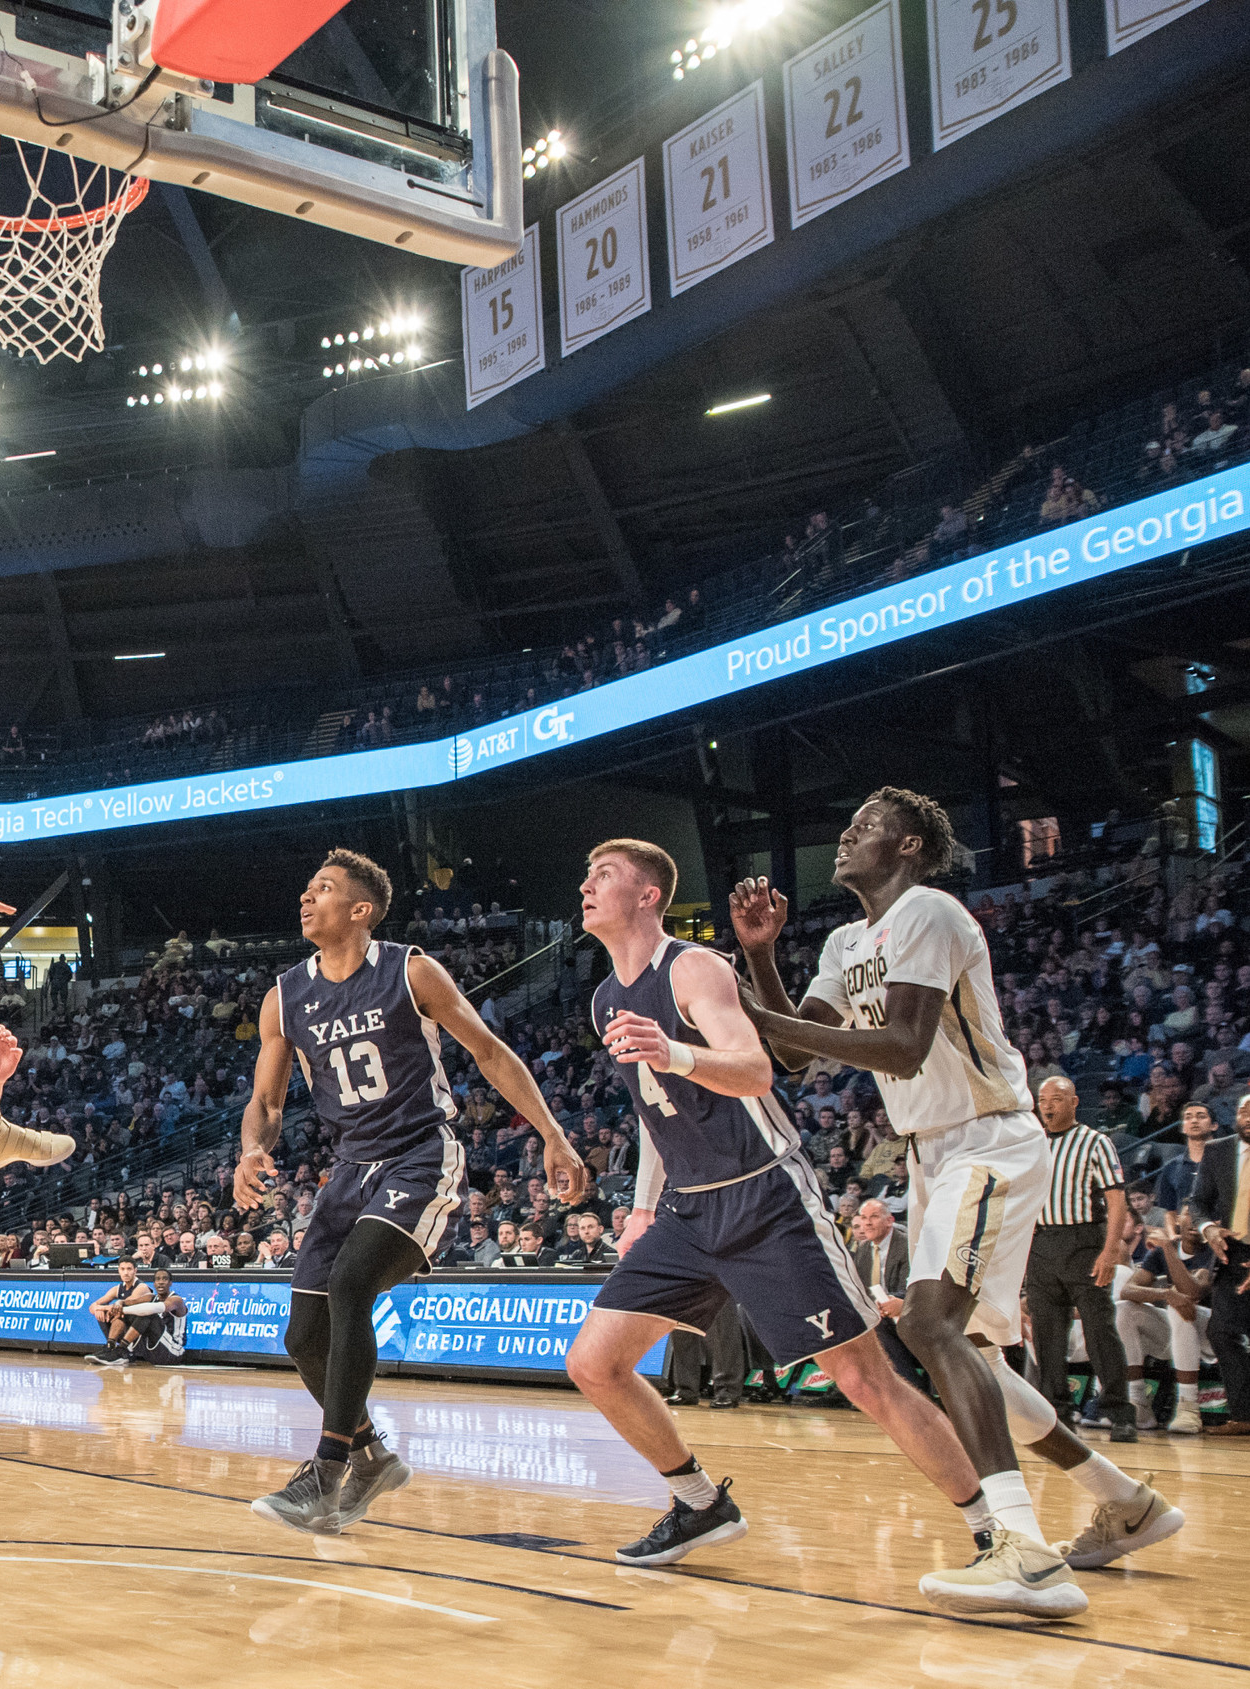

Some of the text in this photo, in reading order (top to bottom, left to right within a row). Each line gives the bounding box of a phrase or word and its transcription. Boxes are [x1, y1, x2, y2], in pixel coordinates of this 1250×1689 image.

[972, 0, 1018, 53] 25
[814, 33, 865, 81] SALLEY
[954, 64, 987, 99] 1983
[1004, 36, 1039, 69] 1986
[823, 75, 864, 140] 22
[690, 118, 734, 160] KAISER
[809, 157, 838, 182] 1983
[852, 131, 883, 156] 1986
[701, 155, 730, 213] 21
[571, 185, 628, 234] HAMMONDS
[687, 227, 712, 252] 1958
[725, 205, 749, 230] 1961
[474, 249, 524, 294] HARPRING
[586, 227, 617, 280] 20
[489, 288, 514, 336] 15
[575, 293, 597, 316] 1986
[608, 274, 631, 297] 1989
[479, 350, 498, 372] 1995
[507, 333, 527, 355] 1998
[727, 488, 1244, 680] Proud Sponsor of the Georgia
[476, 727, 519, 760] AT&T
[99, 794, 174, 821] Yellow
[308, 1008, 386, 1046] YALE
[329, 1041, 389, 1107] 13
[638, 1061, 678, 1117] 4
[384, 1189, 409, 1209] Y
[212, 1255, 231, 1265] POSS
[34, 1318, 72, 1332] UNION
[206, 1297, 240, 1316] Credit
[242, 1299, 277, 1316] Union
[805, 1308, 836, 1339] Y
[221, 1322, 279, 1337] ATHLETICS
[415, 1333, 568, 1356] CREDIT UNION
